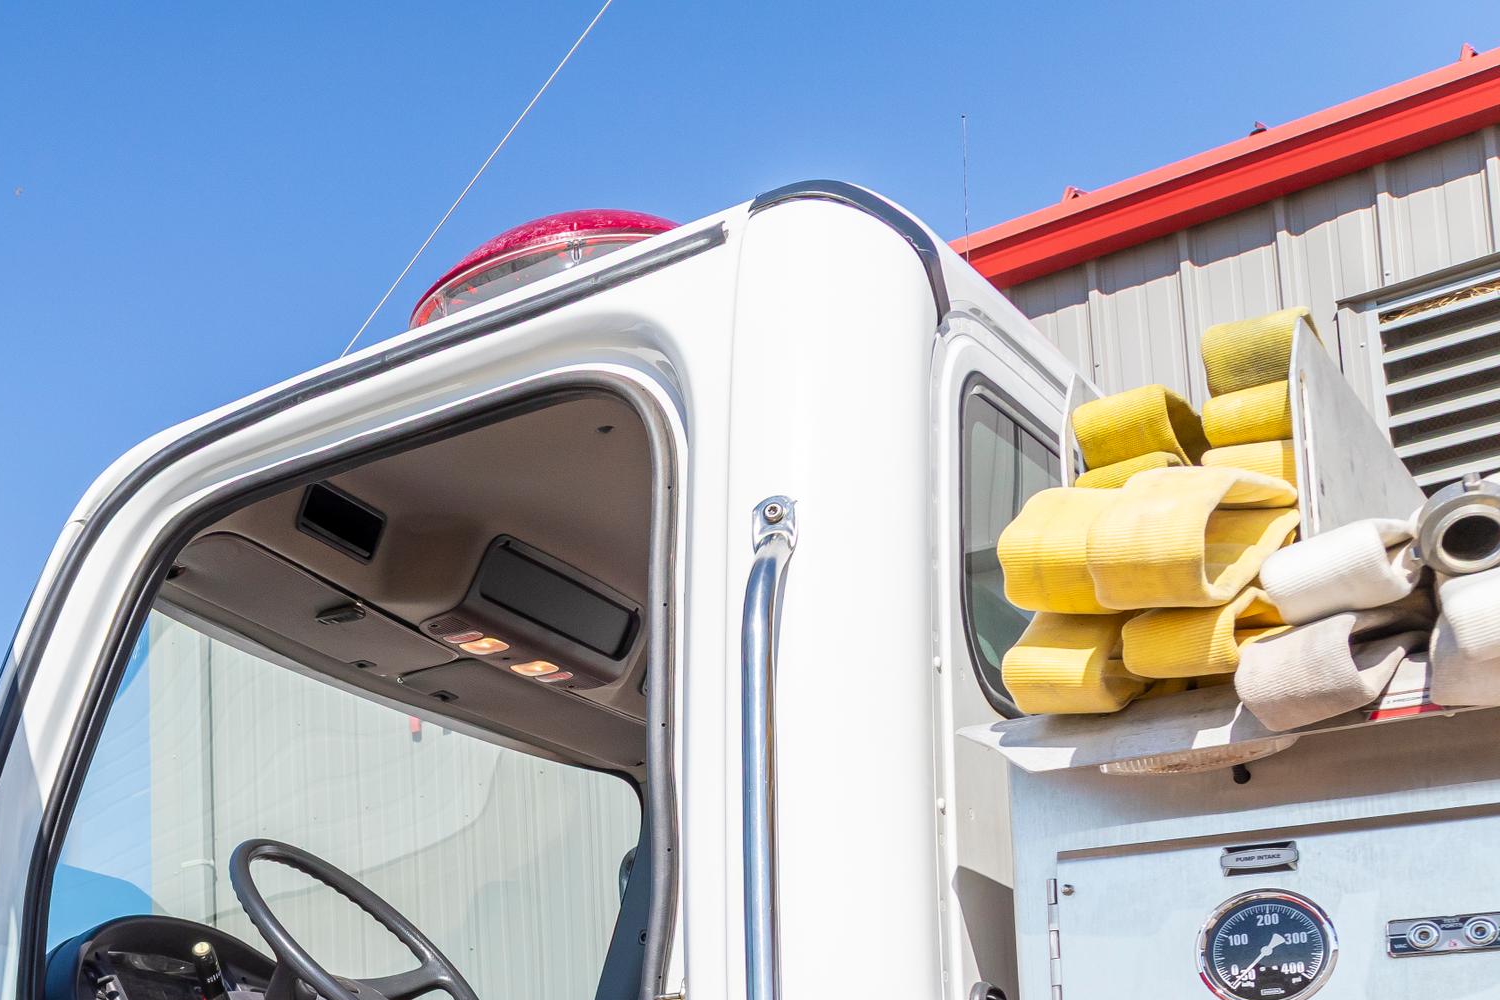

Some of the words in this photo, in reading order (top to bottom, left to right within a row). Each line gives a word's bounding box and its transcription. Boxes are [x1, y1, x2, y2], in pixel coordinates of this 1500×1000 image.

[1256, 913, 1279, 926] 200
[1228, 933, 1248, 946] 100
[1284, 932, 1307, 945] 300
[1231, 964, 1239, 976] 0
[1281, 961, 1305, 975] 400
